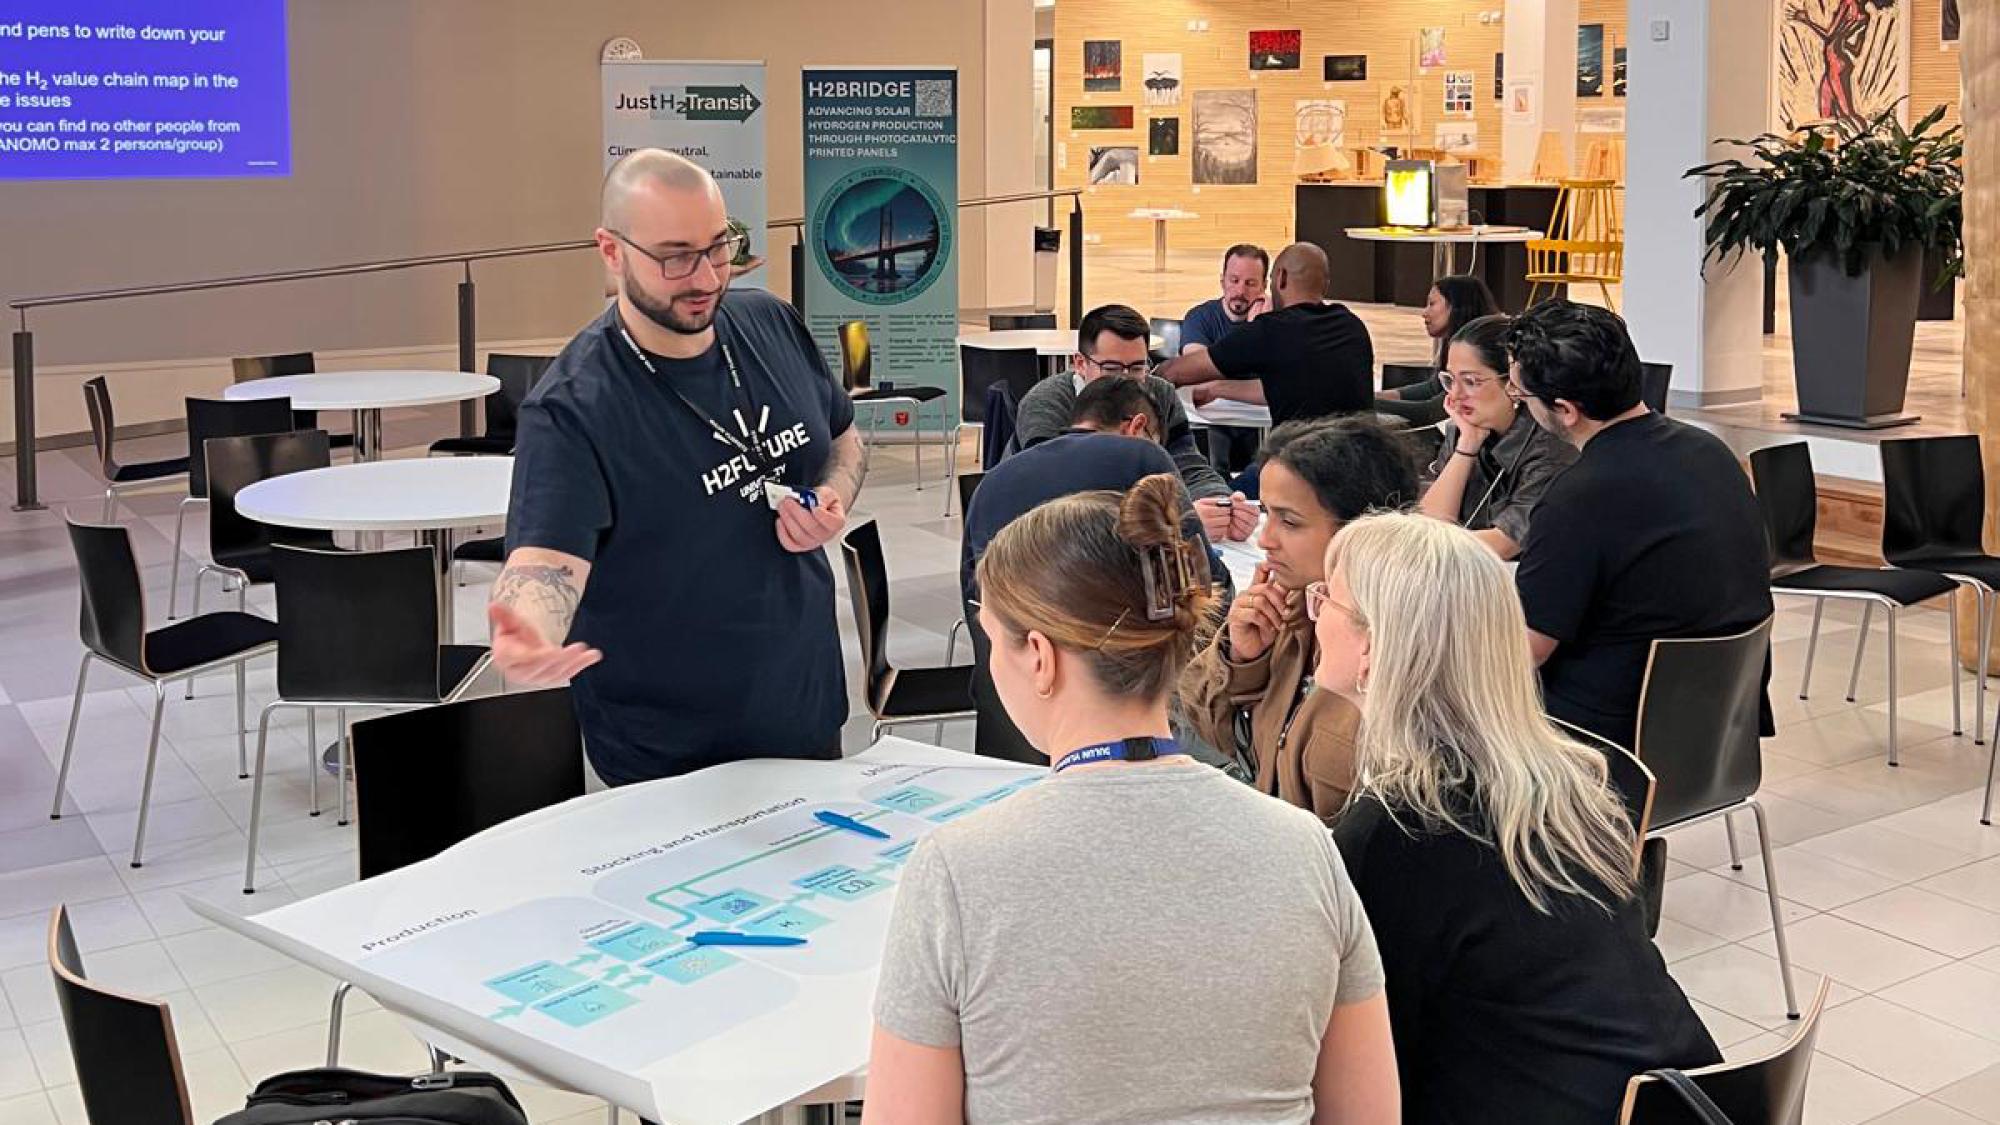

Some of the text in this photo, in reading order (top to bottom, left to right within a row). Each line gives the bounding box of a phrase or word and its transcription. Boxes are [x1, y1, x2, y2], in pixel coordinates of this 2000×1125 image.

[28, 25, 70, 41] pens
[75, 24, 91, 39] to
[95, 25, 136, 40] write
[140, 26, 186, 41] down
[190, 29, 226, 44] your
[52, 71, 99, 87] value
[103, 72, 149, 87] chain
[153, 74, 190, 90] map
[194, 73, 208, 88] in
[213, 74, 239, 89] the
[809, 81, 911, 98] H2BRIDGE
[16, 93, 72, 107] issues
[808, 106, 911, 116] ADVANCING SOLAR
[27, 121, 55, 133] can
[58, 119, 86, 133] find
[91, 121, 110, 133] no
[113, 120, 151, 133] other
[155, 120, 205, 135] people
[208, 119, 241, 133] from
[808, 121, 943, 131] HYDROGEN PRODUCTION
[64, 139, 97, 151] max
[100, 138, 111, 151] 2
[115, 138, 223, 154] persons/group)
[809, 134, 956, 144] THROUGH PHOTOCATALYTIC
[809, 147, 898, 158] PRINTED PANELS
[711, 168, 762, 180] tainable
[581, 847, 664, 876] Stocking
[663, 834, 695, 850] and
[695, 797, 806, 838] transportation
[361, 909, 478, 951] Production
